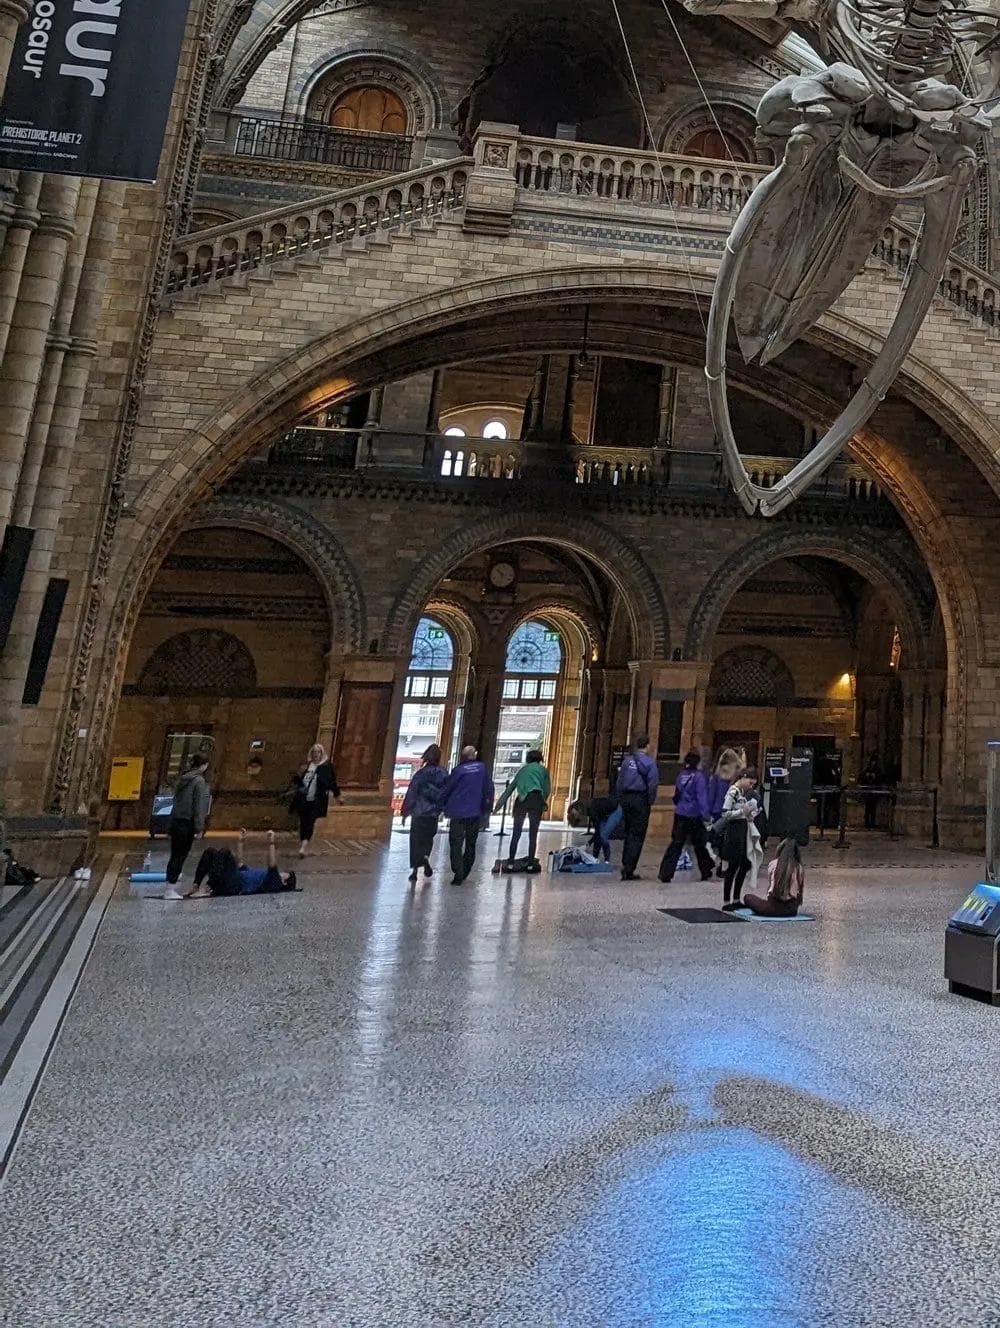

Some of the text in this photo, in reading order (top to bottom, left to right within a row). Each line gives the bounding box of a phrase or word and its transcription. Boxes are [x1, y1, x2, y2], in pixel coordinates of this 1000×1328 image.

[2, 126, 83, 145] PREHISTORIC PLANET 2
